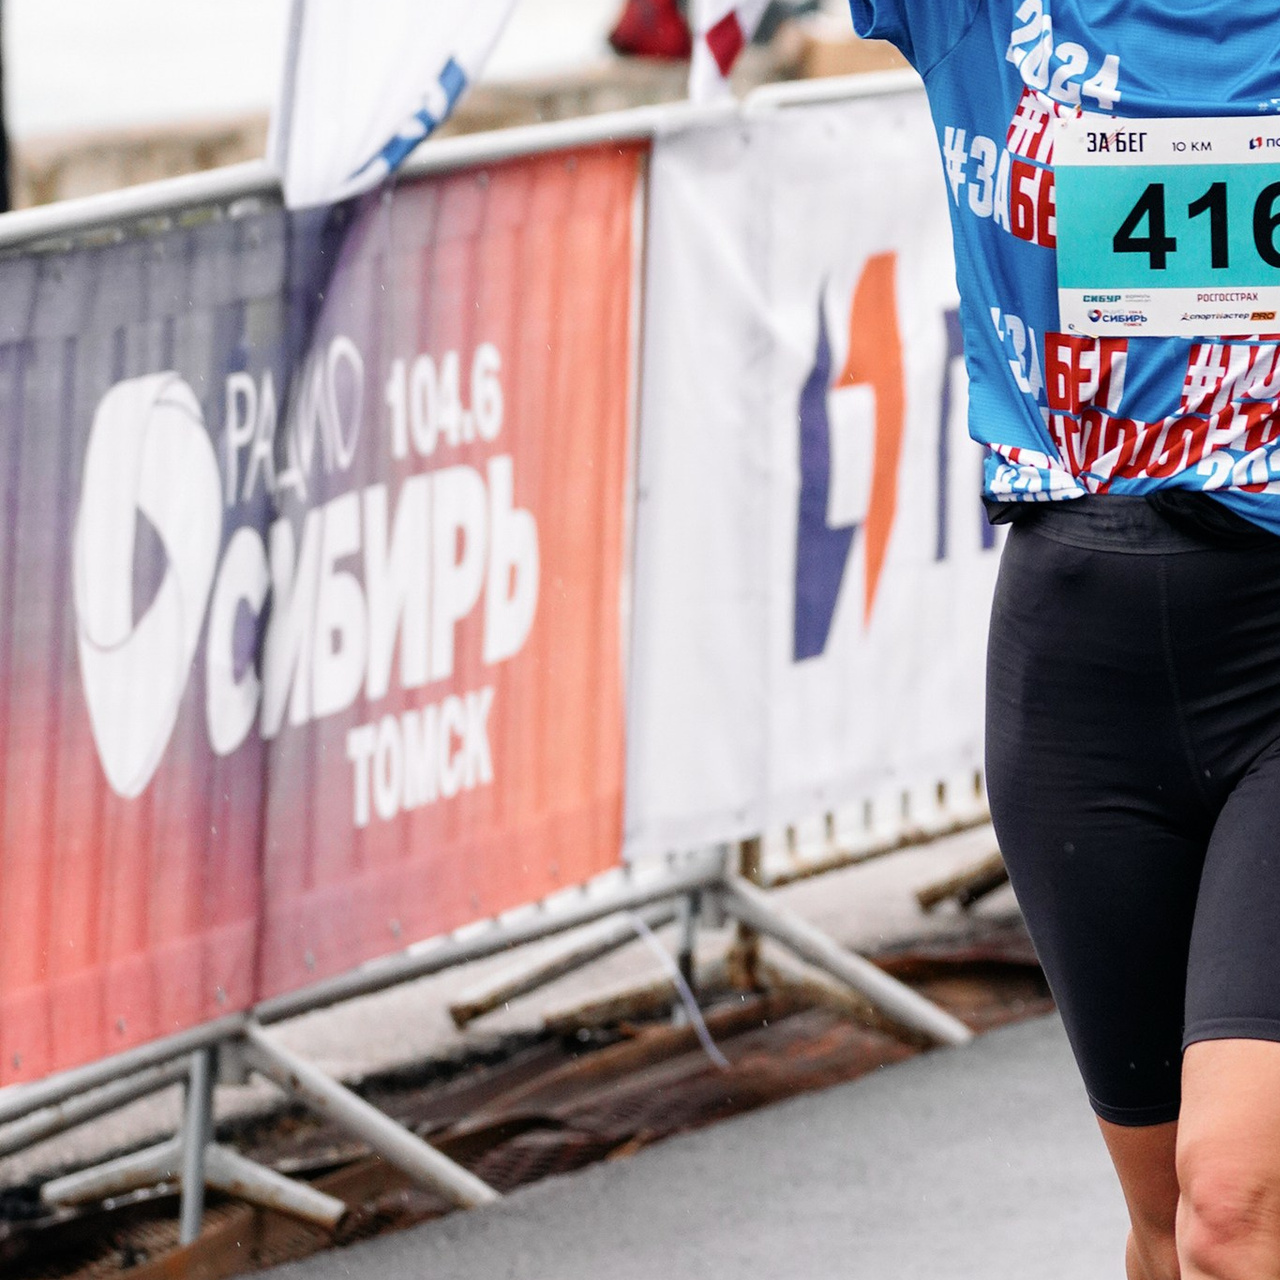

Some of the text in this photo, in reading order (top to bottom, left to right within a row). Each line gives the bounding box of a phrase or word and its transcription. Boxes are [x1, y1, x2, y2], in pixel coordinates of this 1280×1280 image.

[1171, 140, 1212, 152] 10 КМ
[943, 125, 1056, 250] #ЗАБЕ
[1083, 295, 1121, 303] СИБУР
[1197, 293, 1258, 302] РОСГОССТРАХ
[1102, 314, 1147, 323] СИБИРЬ
[1250, 312, 1276, 320] PRO
[225, 335, 504, 507] РАДИО 104.6
[205, 455, 540, 757] СИБИРЬ
[346, 686, 494, 827] ТОМСК
